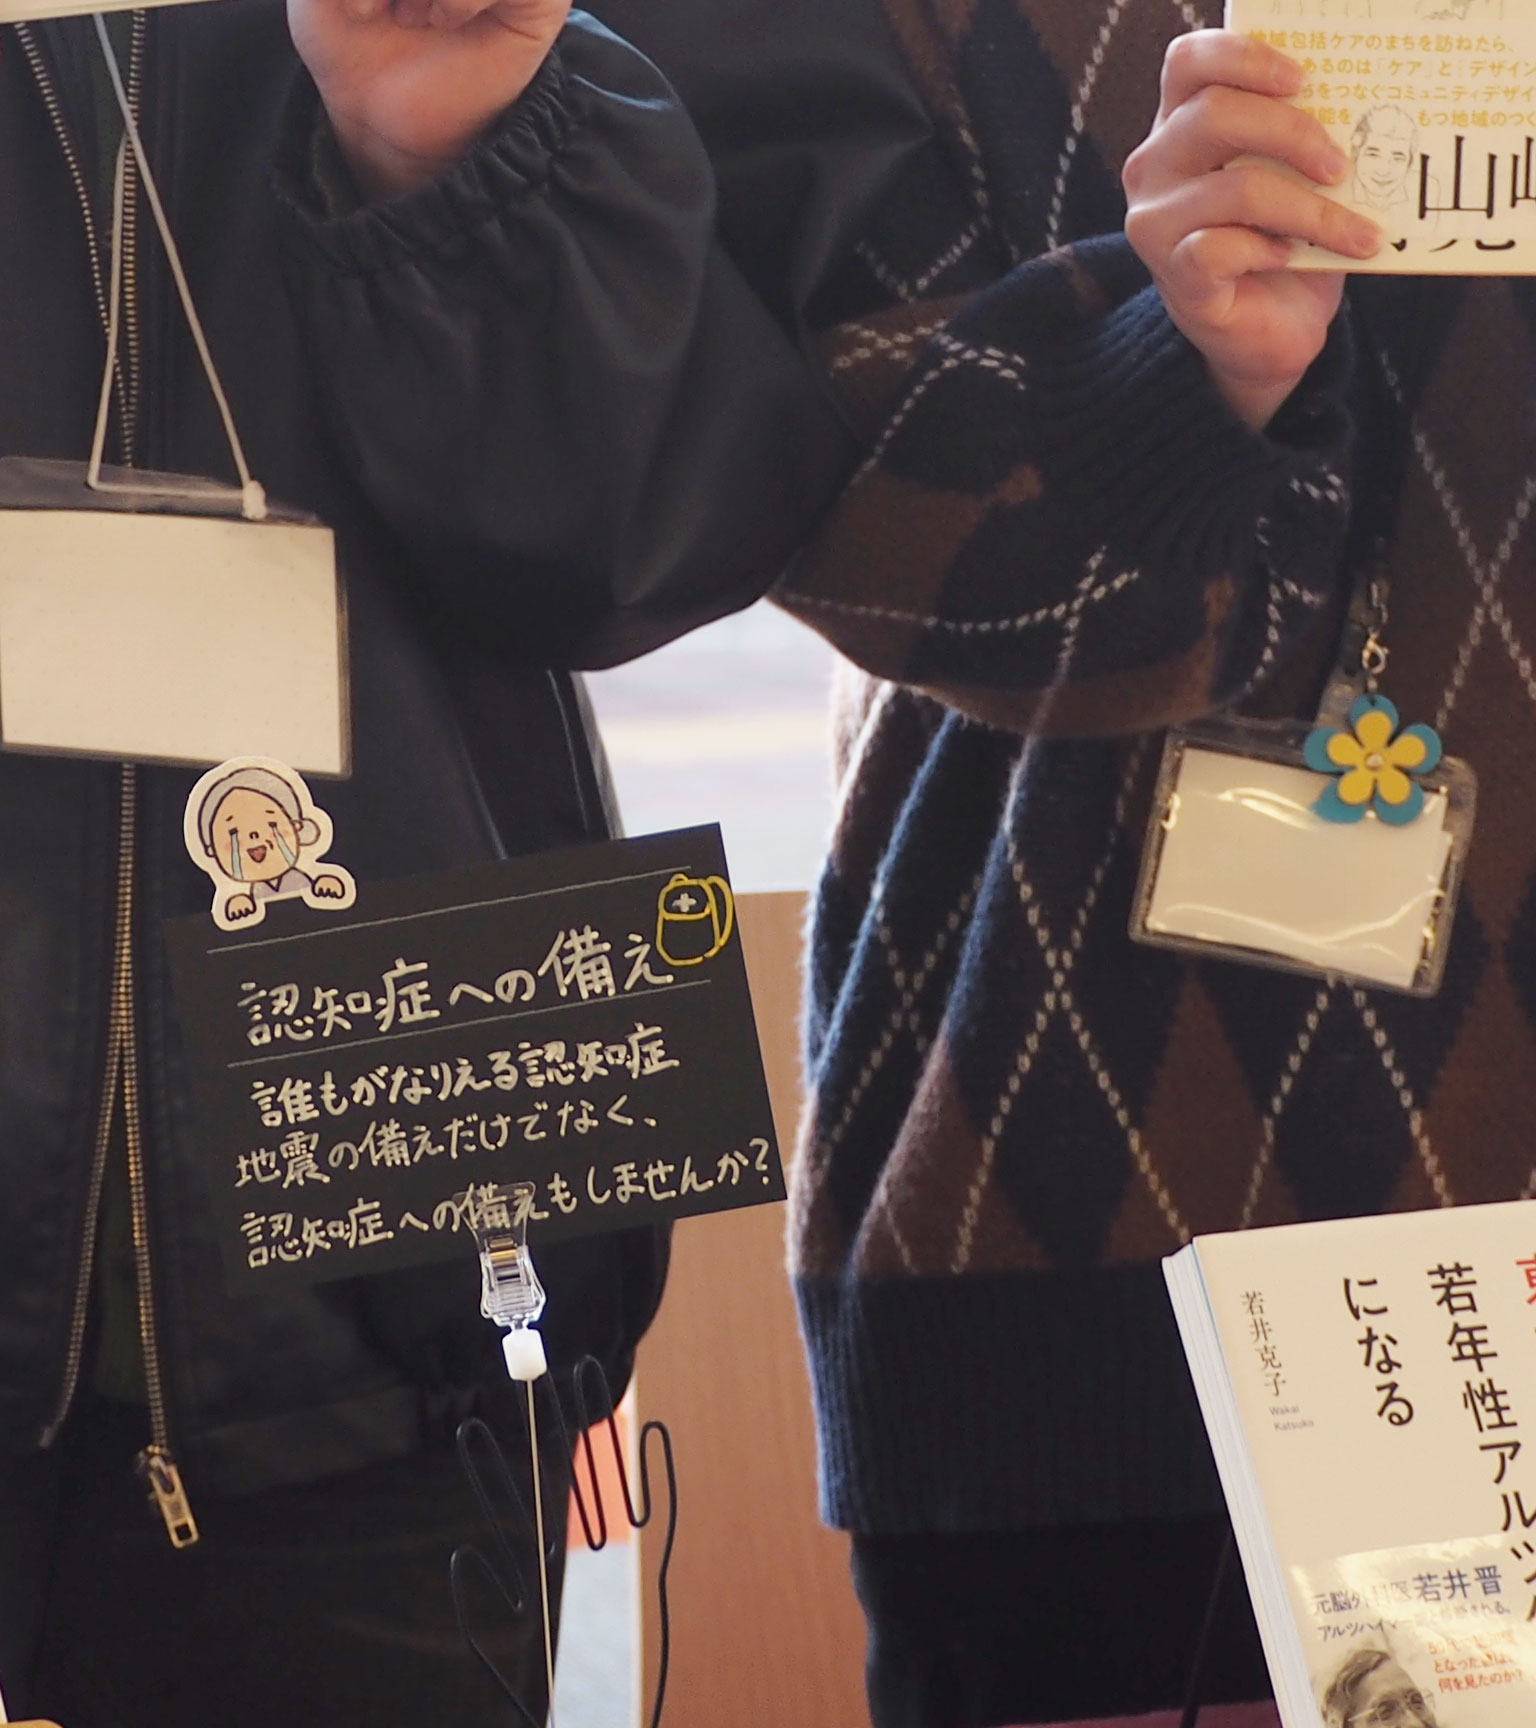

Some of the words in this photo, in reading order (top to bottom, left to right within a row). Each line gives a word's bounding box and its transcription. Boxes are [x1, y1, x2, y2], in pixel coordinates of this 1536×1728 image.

[236, 924, 674, 1047] 認知症への備え
[250, 1023, 679, 1127] 誰もがなりえる認知症
[234, 1094, 658, 1189] 地震の備えだけでなく、
[240, 1137, 770, 1268] 認知症への備えもしませんか？
[1240, 1291, 1286, 1396] 若井克子
[1343, 1276, 1415, 1426] になる
[1269, 1405, 1300, 1416] Wakai
